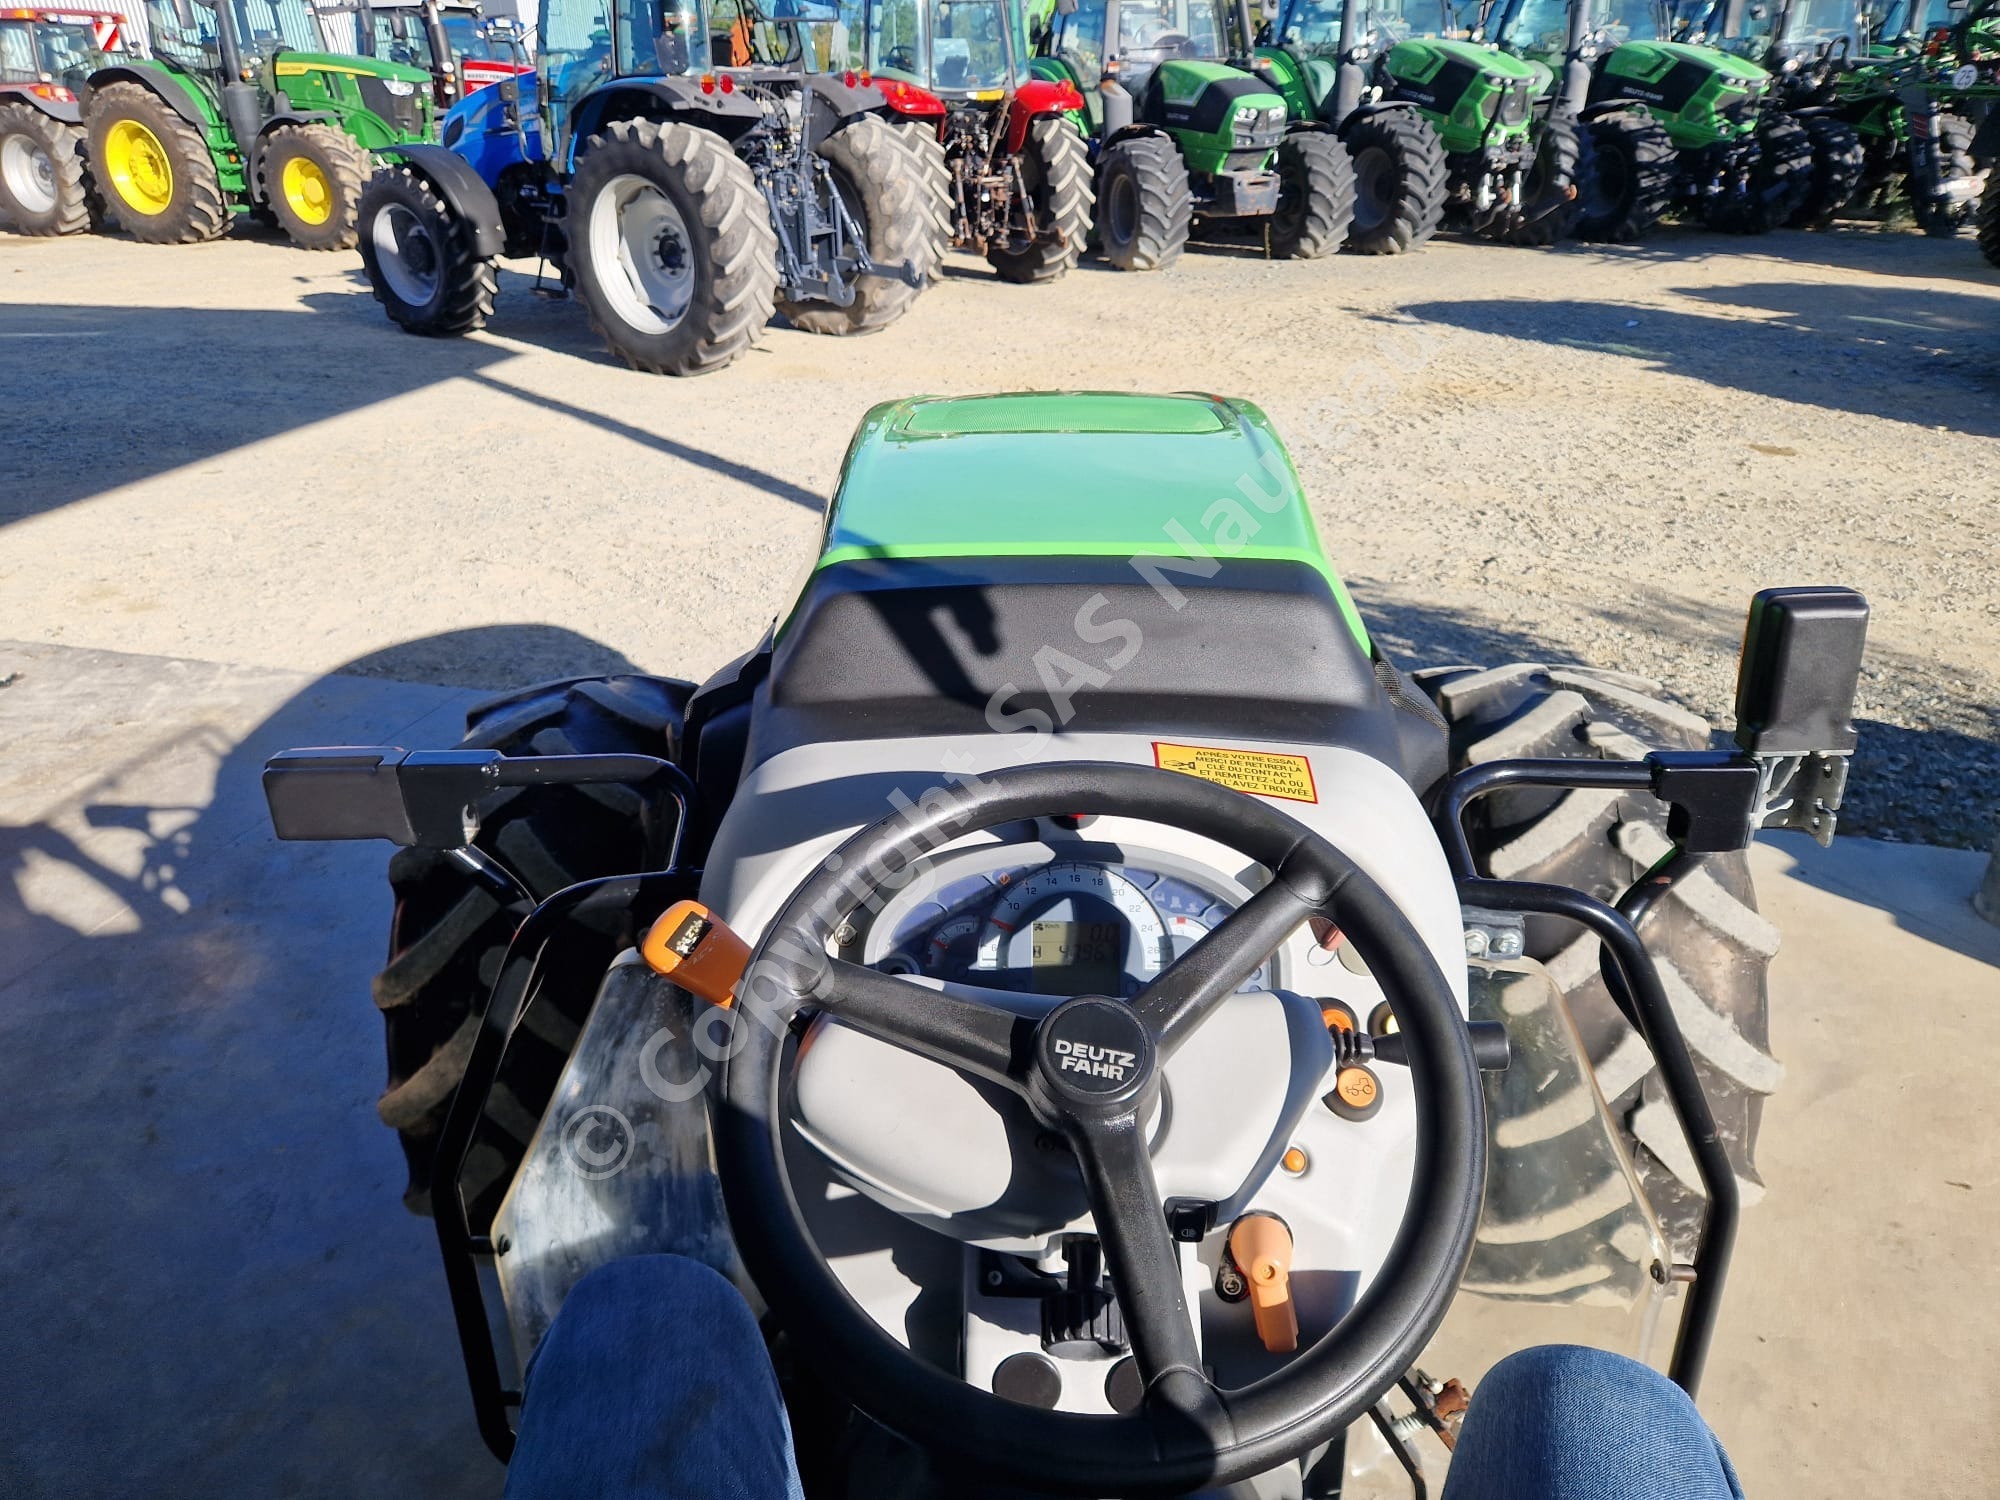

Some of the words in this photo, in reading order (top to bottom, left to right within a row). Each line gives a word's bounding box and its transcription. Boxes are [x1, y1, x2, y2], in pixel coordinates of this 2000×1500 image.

[1231, 754, 1265, 763] VOTRE
[1195, 756, 1227, 765] MERCI
[1245, 761, 1288, 771] RETIRER
[1244, 768, 1294, 778] CONTACT
[1215, 771, 1287, 786] REMETTEZ-LA
[1224, 779, 1259, 790] L'AVEZ
[1046, 878, 1057, 886] 14
[1069, 875, 1081, 883] 16
[1092, 878, 1104, 887] 18
[1112, 889, 1125, 897] 20
[1008, 902, 1020, 911] 10
[1129, 905, 1142, 913] 22
[1054, 1039, 1136, 1068] DEUTZ
[1061, 1056, 1125, 1081] FAHR
